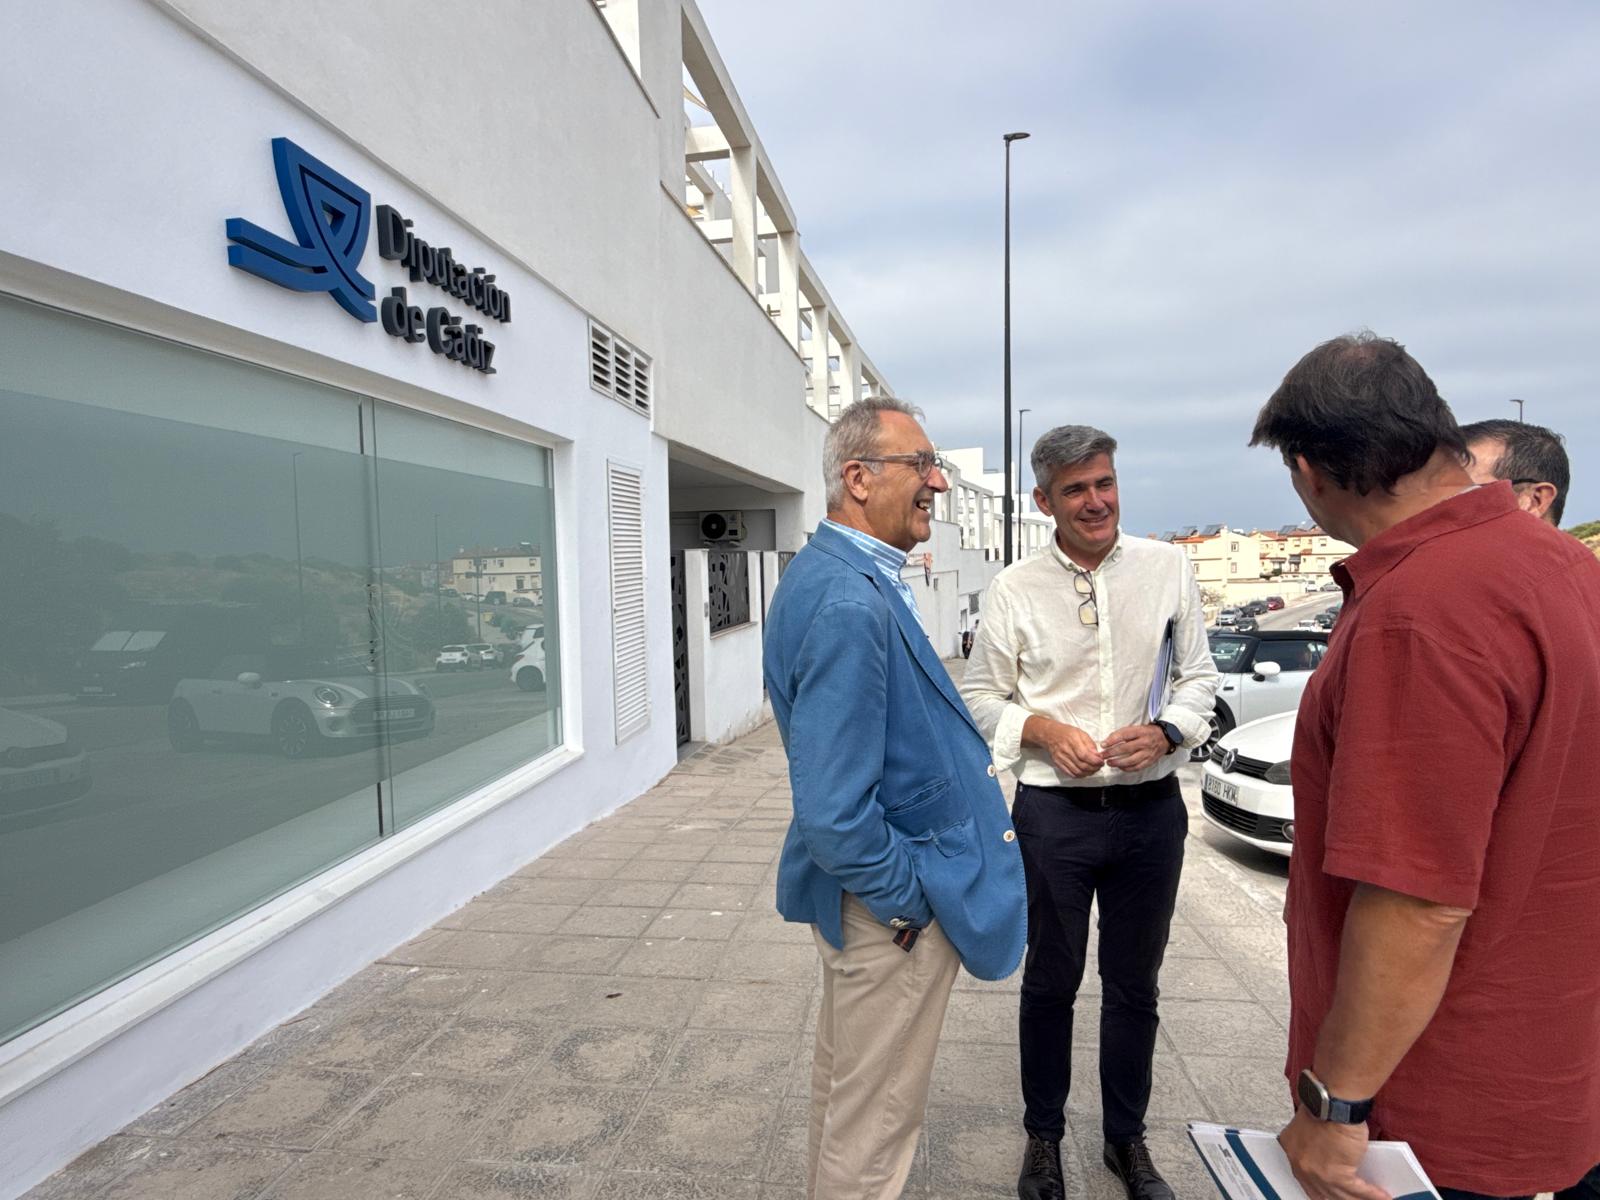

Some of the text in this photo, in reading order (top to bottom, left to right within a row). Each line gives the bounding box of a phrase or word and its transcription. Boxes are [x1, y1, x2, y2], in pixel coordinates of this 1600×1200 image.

[376, 204, 511, 323] Diputación
[381, 286, 497, 374] de Cádiz
